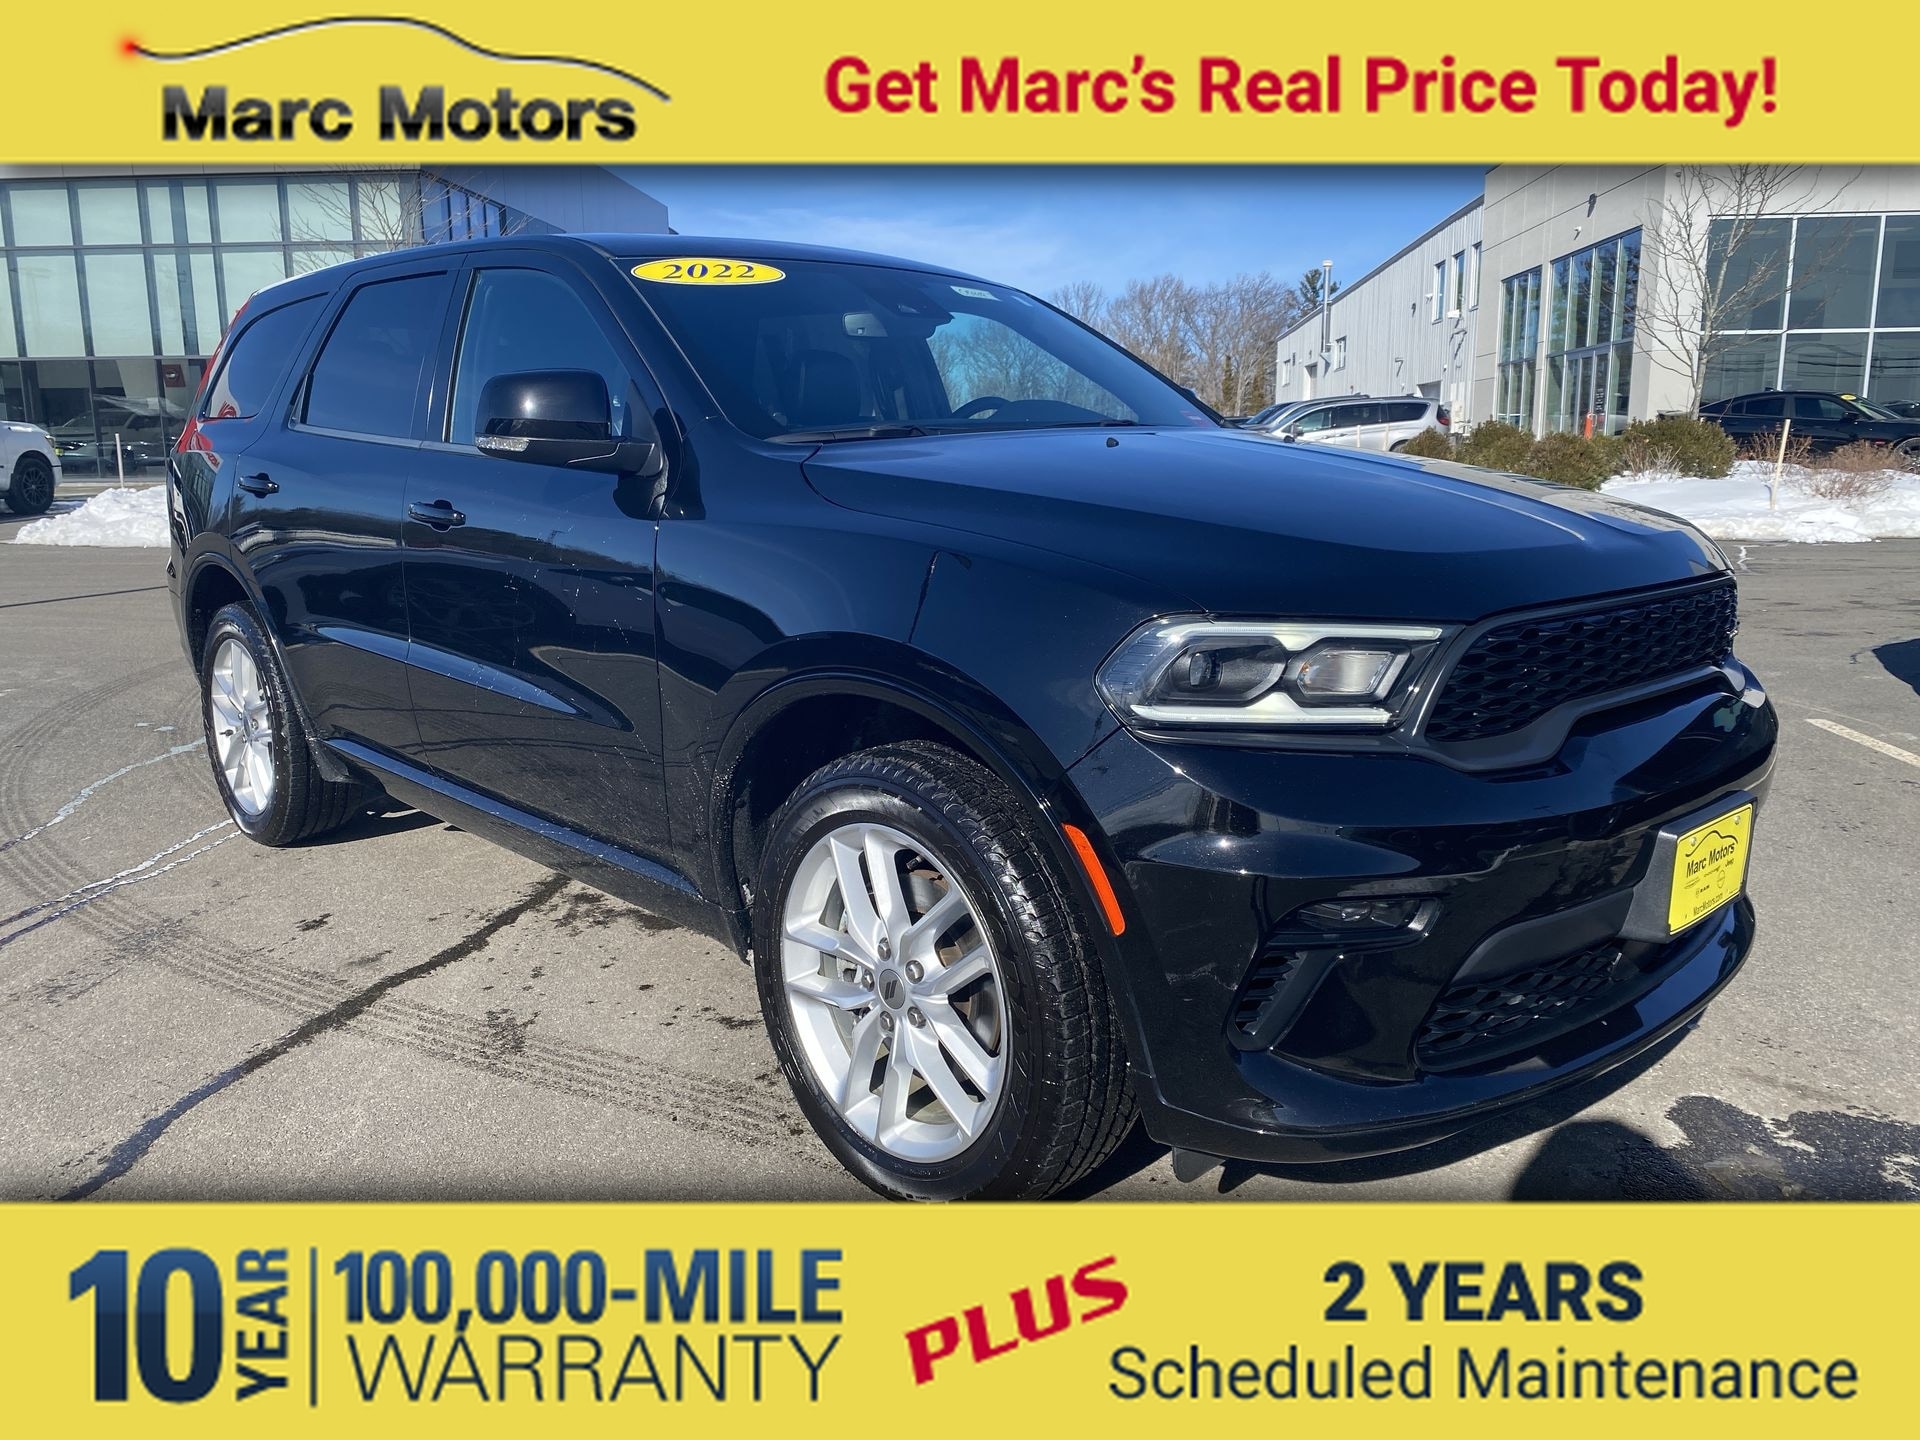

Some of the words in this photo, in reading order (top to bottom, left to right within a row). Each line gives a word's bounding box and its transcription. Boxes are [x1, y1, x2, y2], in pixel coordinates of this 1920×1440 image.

[662, 263, 755, 279] 2022
[1686, 856, 1707, 878] Marc
[1708, 842, 1735, 866] Motors
